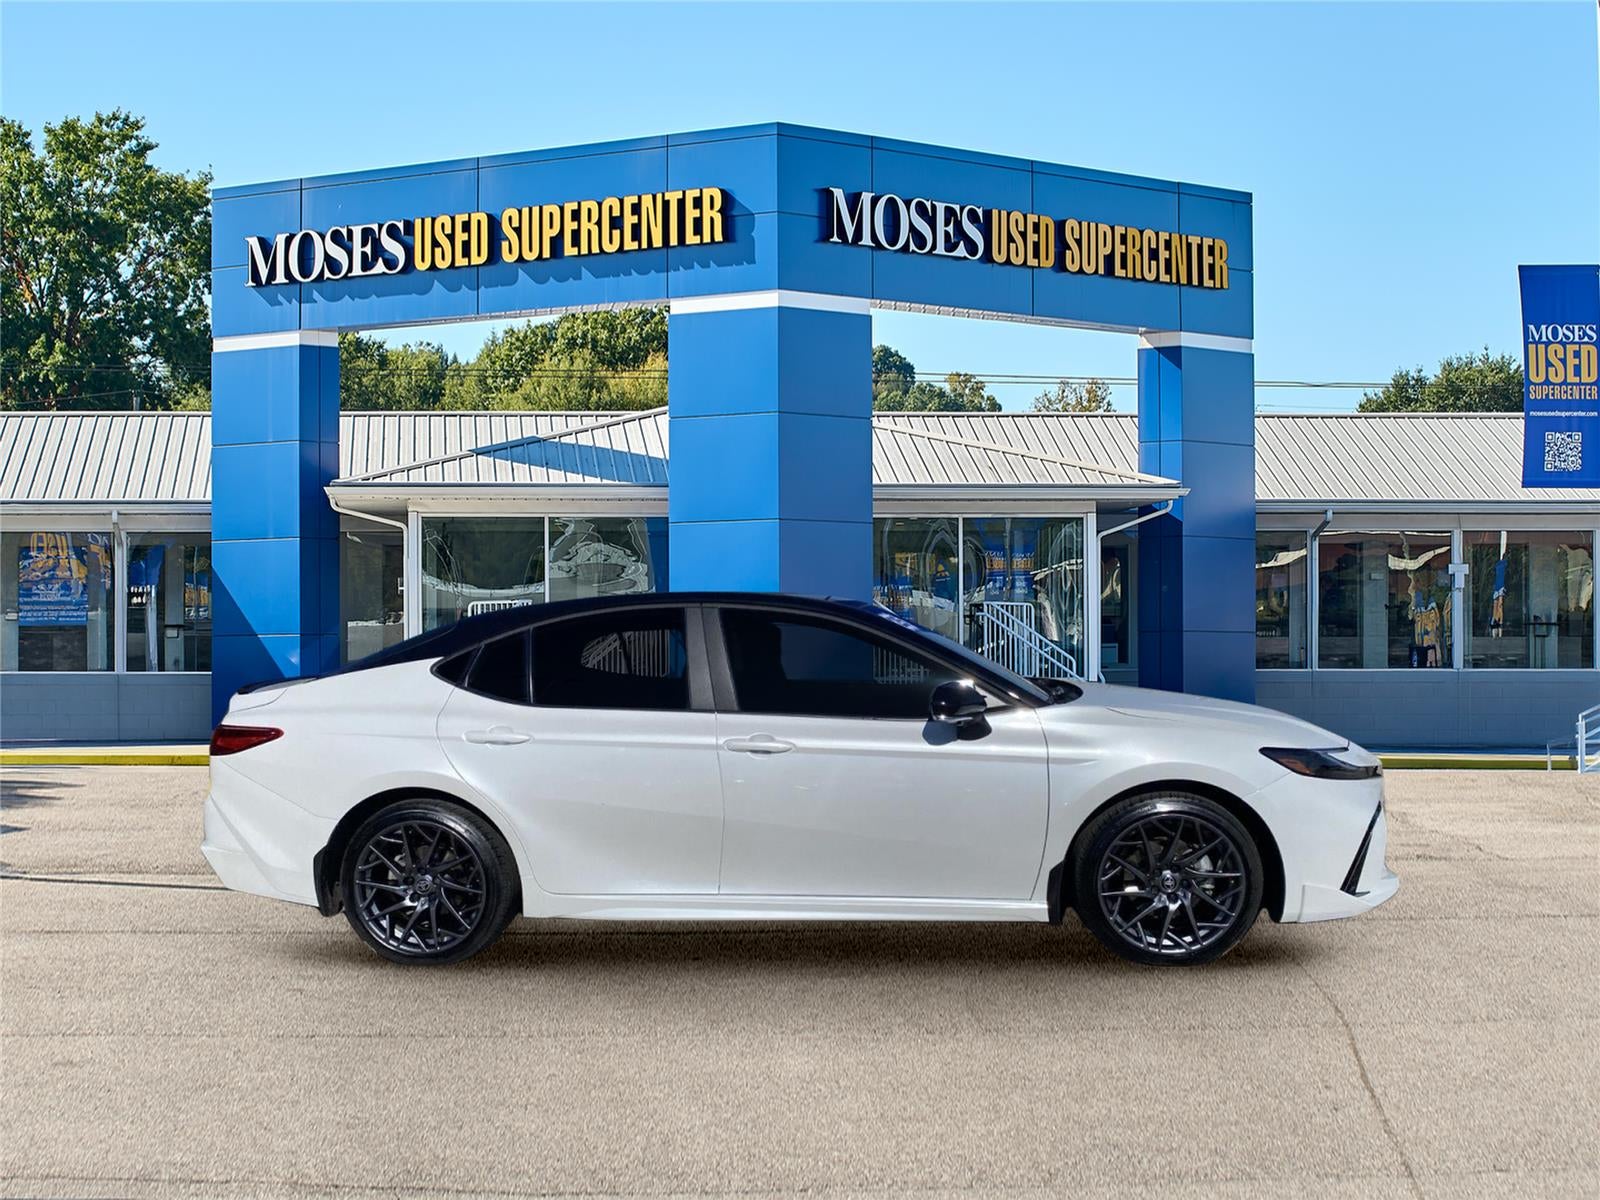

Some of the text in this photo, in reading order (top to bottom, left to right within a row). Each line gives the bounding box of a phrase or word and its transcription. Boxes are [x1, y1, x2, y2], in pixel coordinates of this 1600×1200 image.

[244, 187, 724, 288] MOSES USED SUPERCENTER
[828, 187, 1229, 289] MOSES USED SUPERCENTER
[1528, 324, 1597, 342] MOSES
[1528, 344, 1598, 383] USED
[1529, 385, 1598, 399] SUPERCENTER
[1529, 410, 1598, 418] mosesusedsupercenter.com
